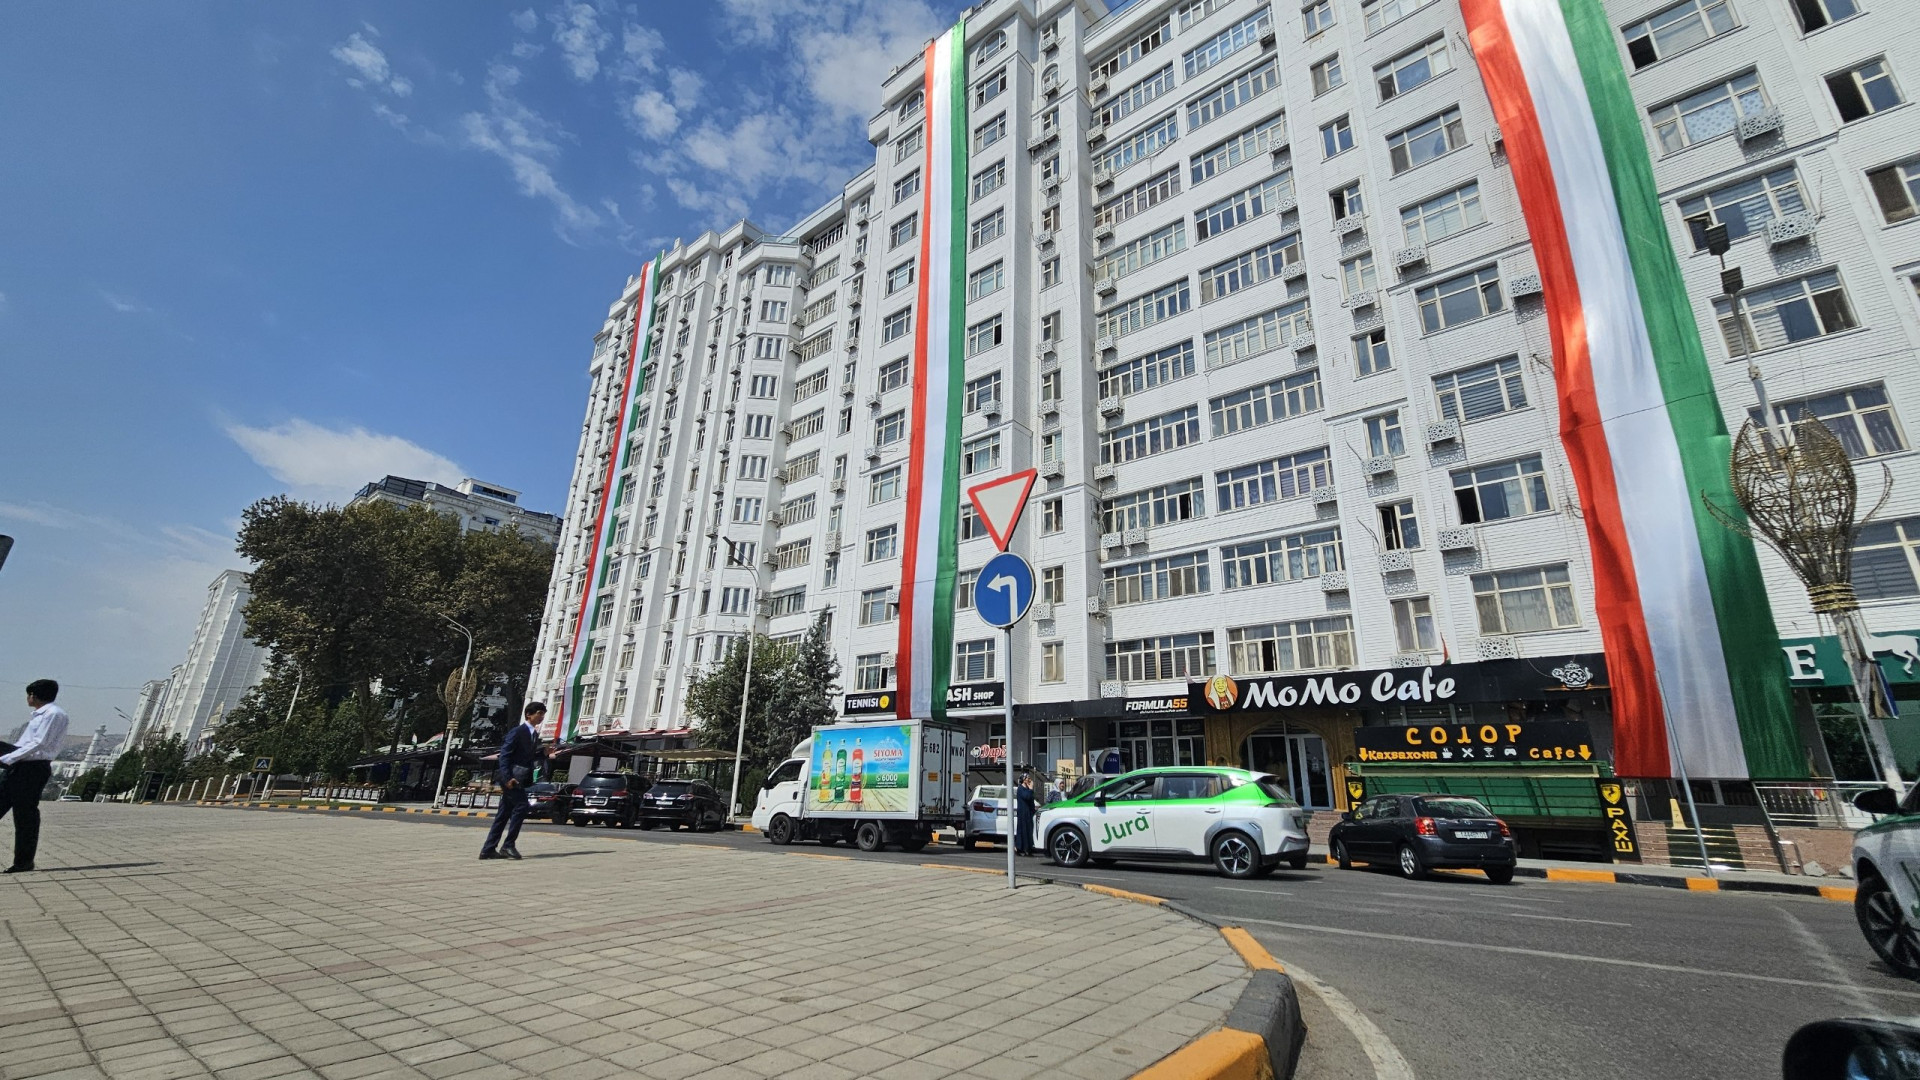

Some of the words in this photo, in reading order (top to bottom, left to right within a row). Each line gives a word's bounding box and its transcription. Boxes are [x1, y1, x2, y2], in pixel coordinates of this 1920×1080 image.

[1242, 677, 1361, 709] MoMo
[1371, 666, 1456, 702] Cafe
[946, 687, 972, 702] ASH
[973, 691, 994, 701] SHOP
[846, 697, 879, 709] TENNISI
[1126, 698, 1188, 711] FORMULA55
[873, 749, 903, 758] SIYOMA
[1529, 746, 1575, 760] Cafe
[881, 773, 898, 782] 6000
[1101, 815, 1150, 844] Jura
